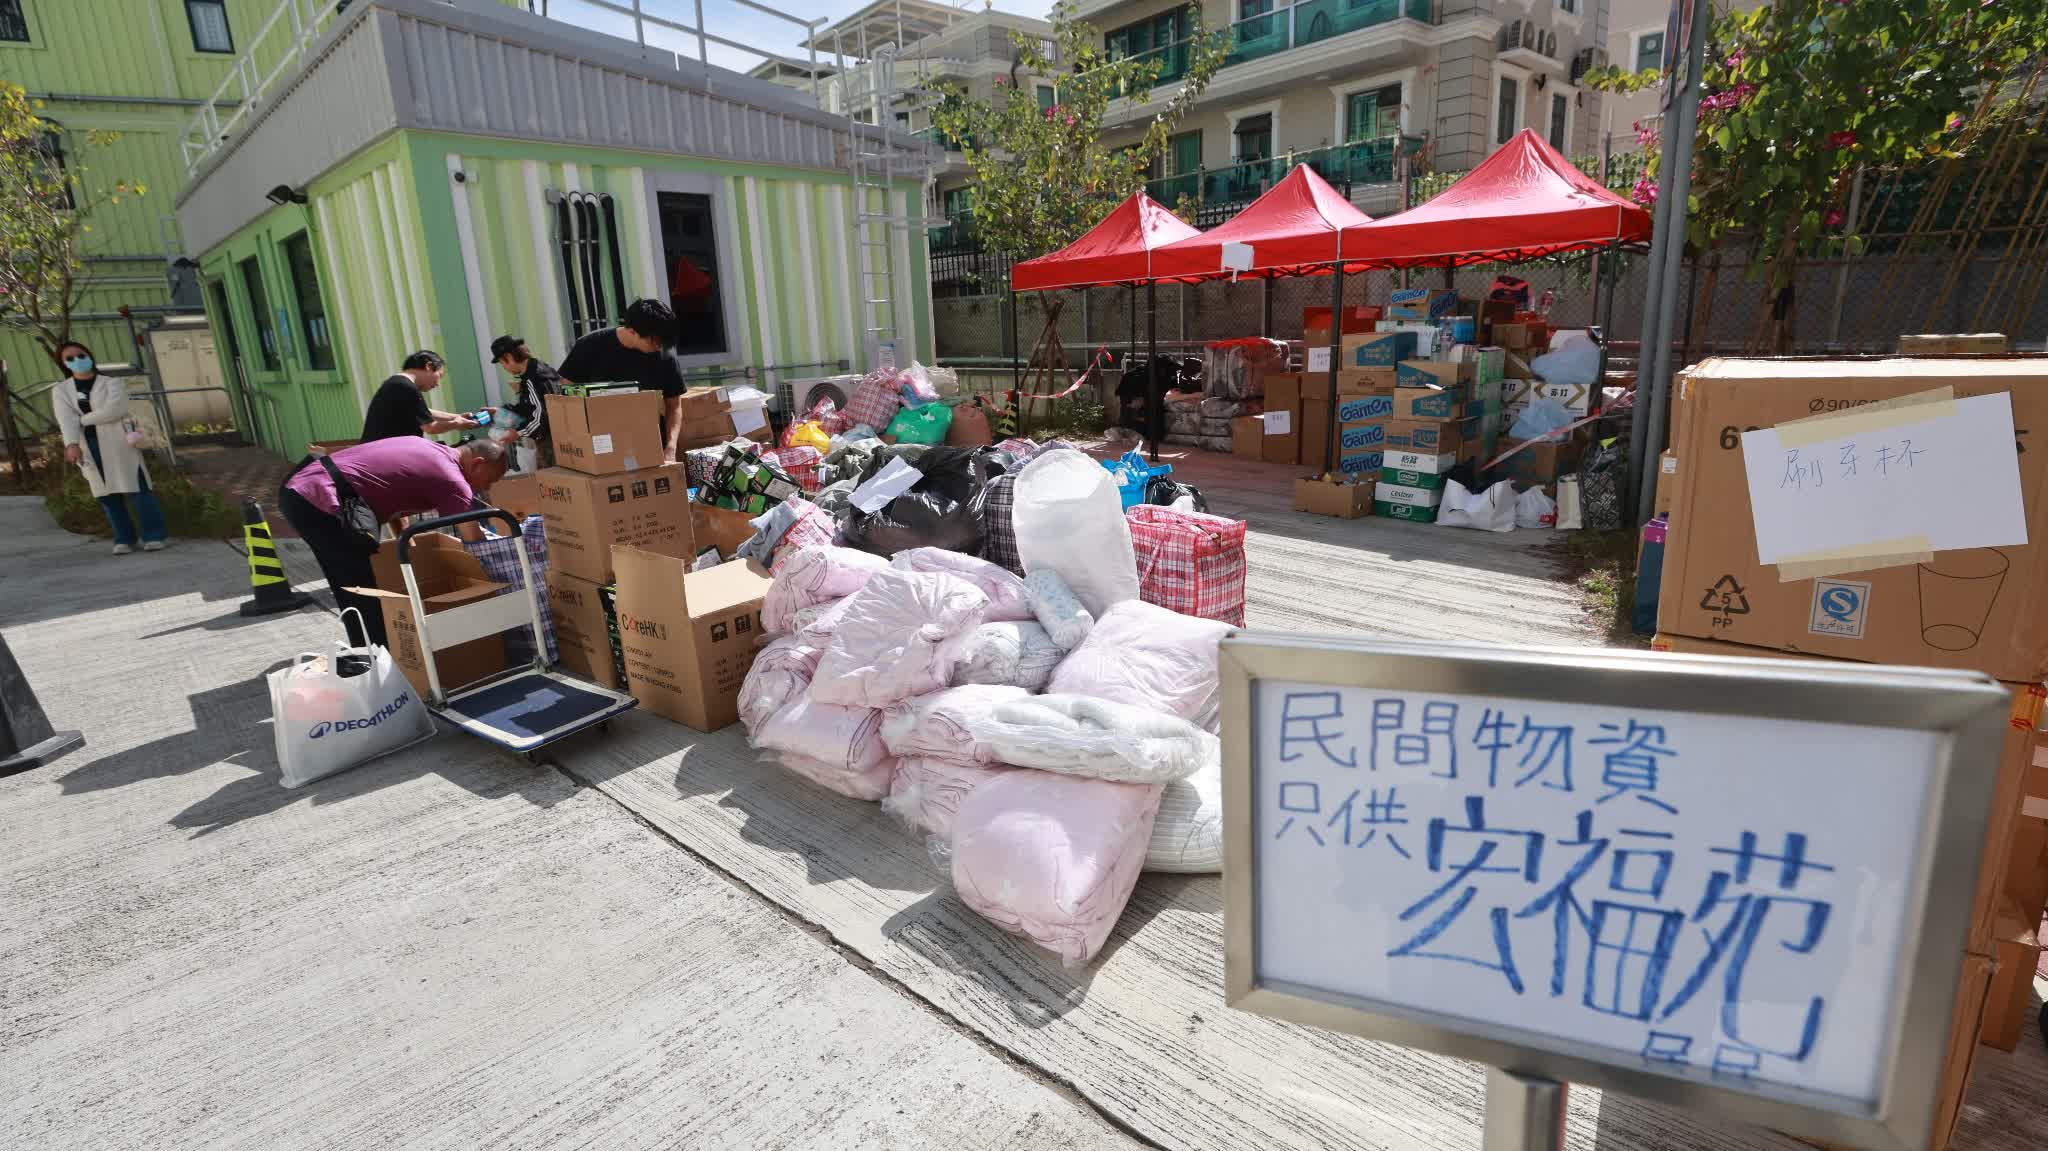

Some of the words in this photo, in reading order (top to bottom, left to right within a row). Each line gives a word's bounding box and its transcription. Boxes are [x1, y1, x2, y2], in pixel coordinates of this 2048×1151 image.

[1340, 399, 1392, 421] Ganten
[1342, 426, 1384, 449] Gante
[1780, 439, 1928, 489] 刷牙杯
[1711, 616, 1734, 628] PP
[334, 691, 409, 733] DECATHLON
[1280, 692, 1678, 815] 民間物資
